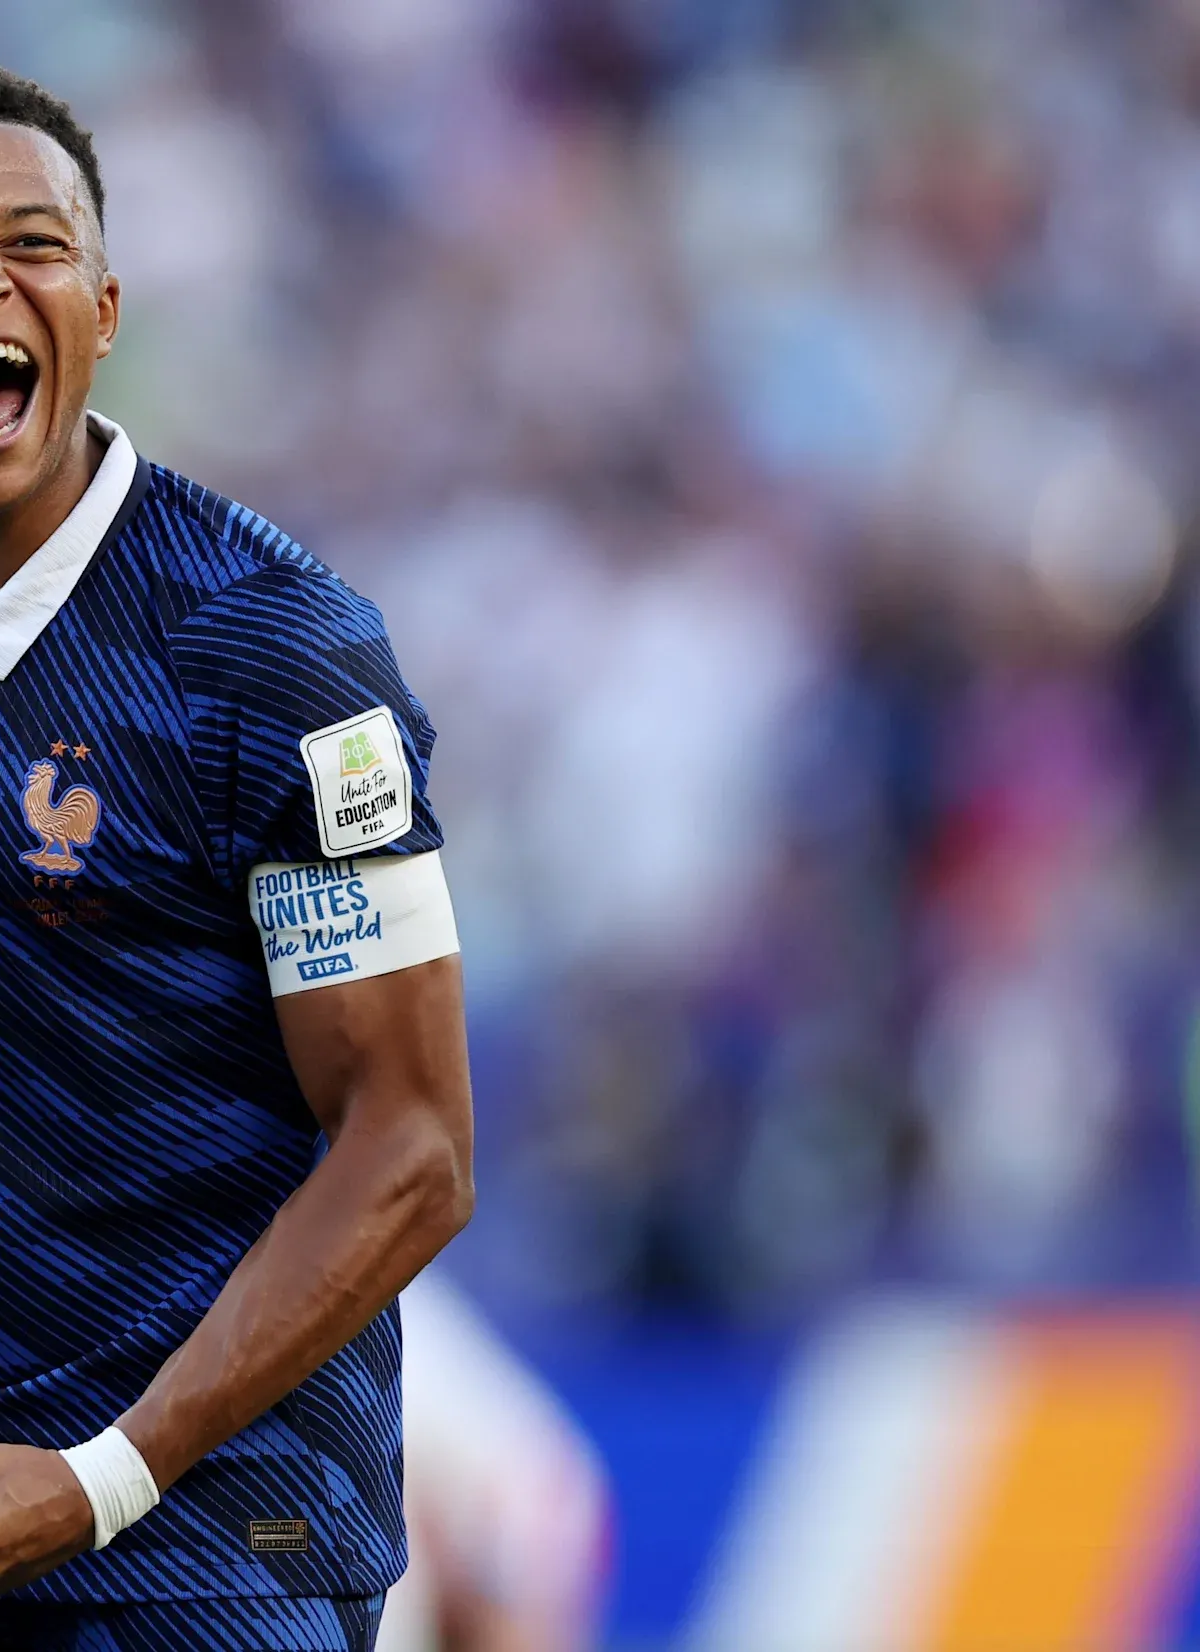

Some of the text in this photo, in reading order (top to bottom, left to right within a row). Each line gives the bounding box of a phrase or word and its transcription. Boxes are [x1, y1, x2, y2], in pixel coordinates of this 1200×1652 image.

[341, 769, 387, 804] Unite For
[335, 789, 397, 828] EDUCATION
[362, 820, 384, 835] FIFA
[255, 860, 361, 899] FOOTBALL
[258, 880, 369, 932] UNITES
[265, 911, 382, 963] the World
[302, 957, 349, 977] FIFA
